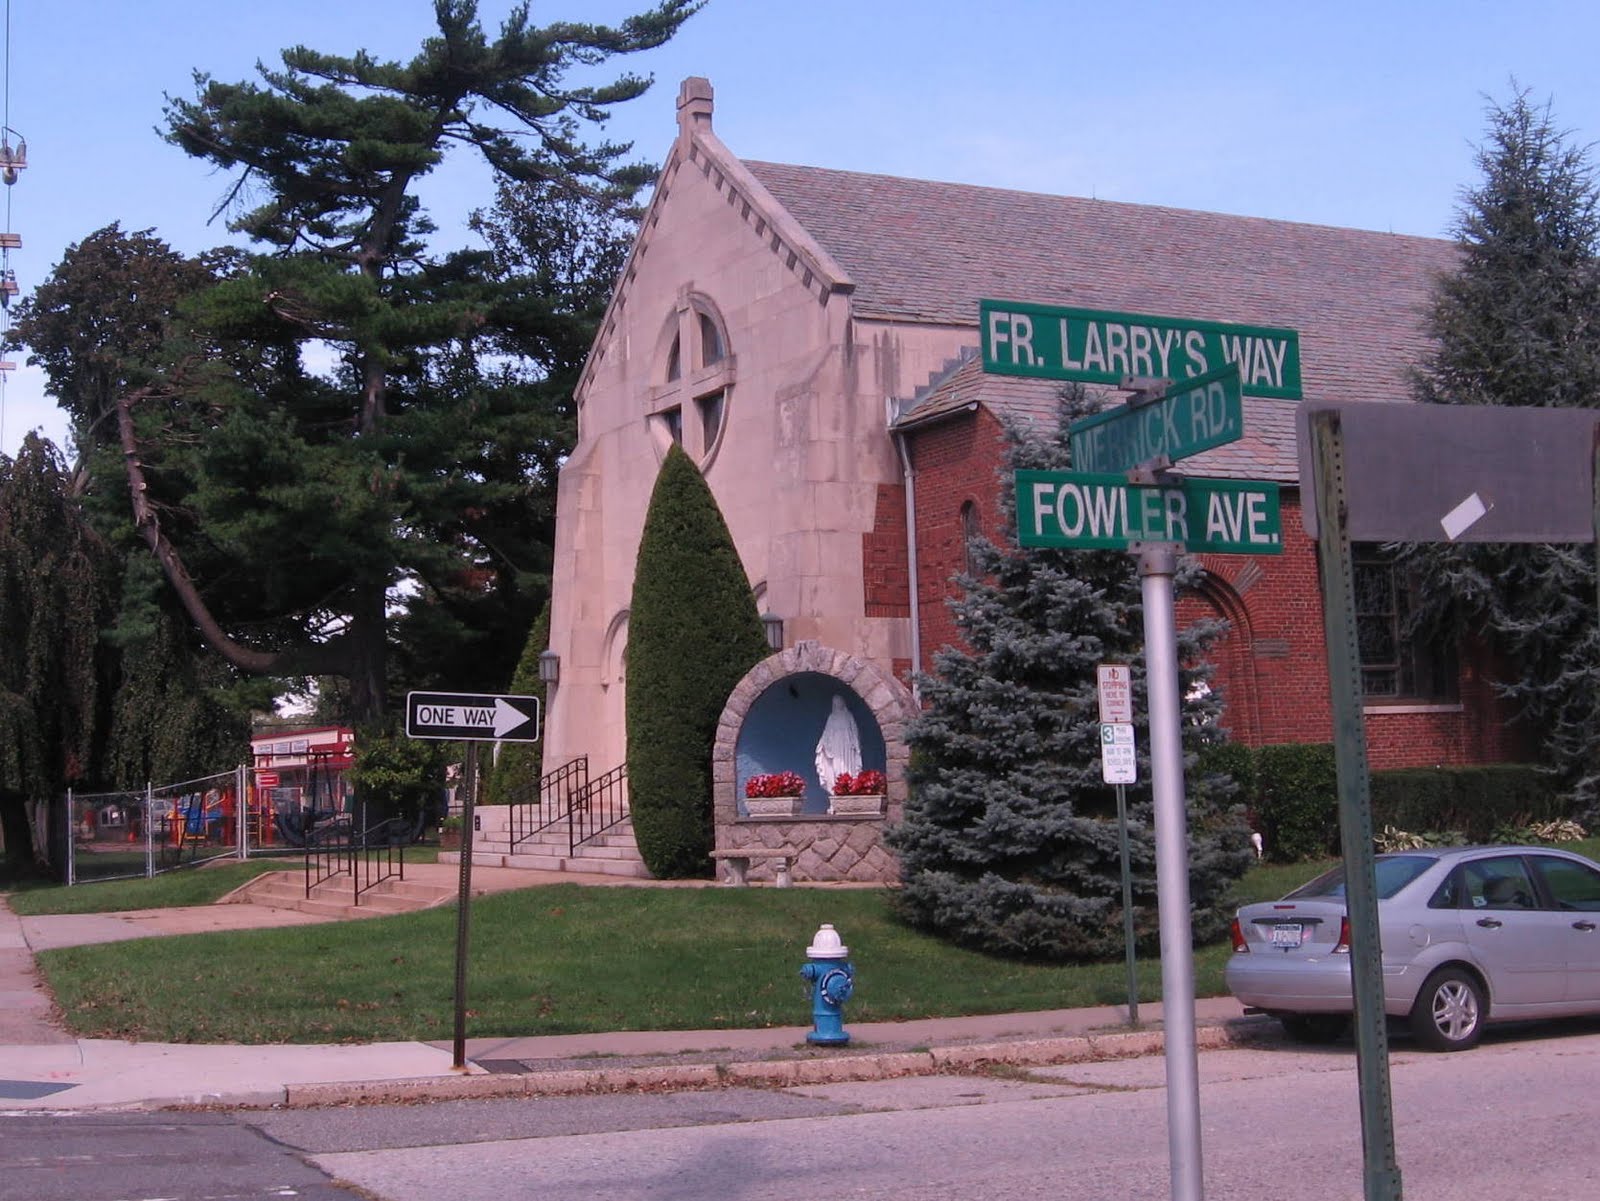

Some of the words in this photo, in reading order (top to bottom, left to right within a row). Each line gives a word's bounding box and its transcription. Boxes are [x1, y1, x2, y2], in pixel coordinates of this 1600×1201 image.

[988, 310, 1045, 367] FR.
[1060, 317, 1208, 380] LARRY'S
[1220, 333, 1288, 389] WAY
[1190, 380, 1234, 444] RD.
[1032, 482, 1189, 541] FOWLER
[1205, 491, 1279, 544] AVE.
[419, 706, 455, 725] ONE
[463, 708, 497, 726] WAY
[1103, 726, 1113, 742] 3
